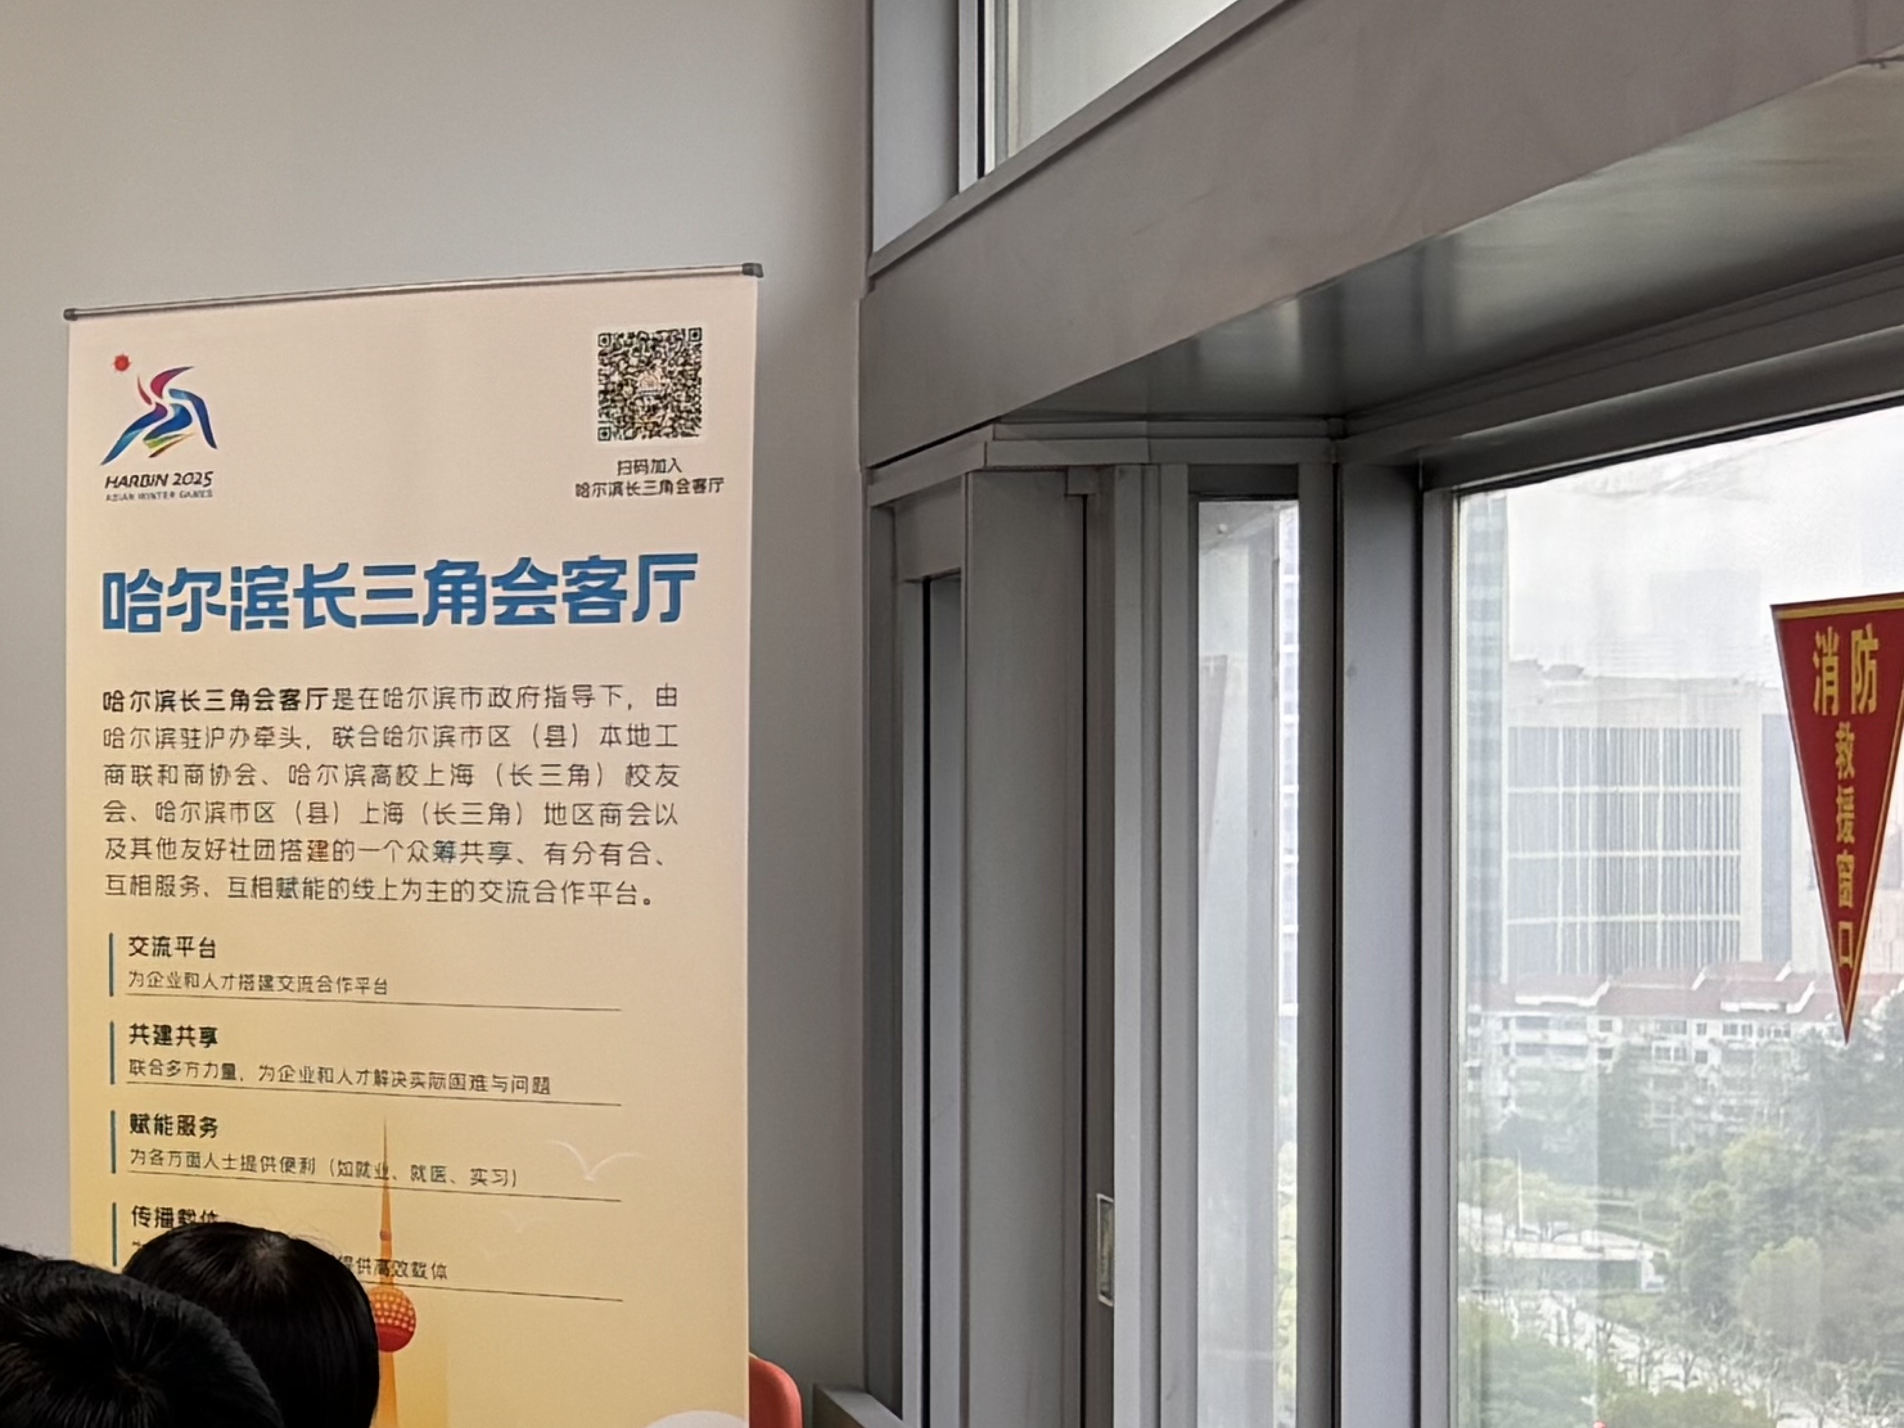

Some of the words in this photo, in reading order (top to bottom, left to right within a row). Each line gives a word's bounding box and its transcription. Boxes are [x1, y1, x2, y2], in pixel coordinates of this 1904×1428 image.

[616, 457, 683, 477] 扫码加入
[104, 473, 169, 489] HARBIN
[172, 471, 214, 488] 2025
[575, 477, 725, 498] 哈尔滨长三角会客厅
[102, 552, 699, 634] 哈尔滨长三角会客厅
[1812, 623, 1880, 717] 消防
[128, 935, 217, 959] 交流平台
[128, 1023, 219, 1049] 共建共享
[129, 1113, 219, 1139] 赋能服务
